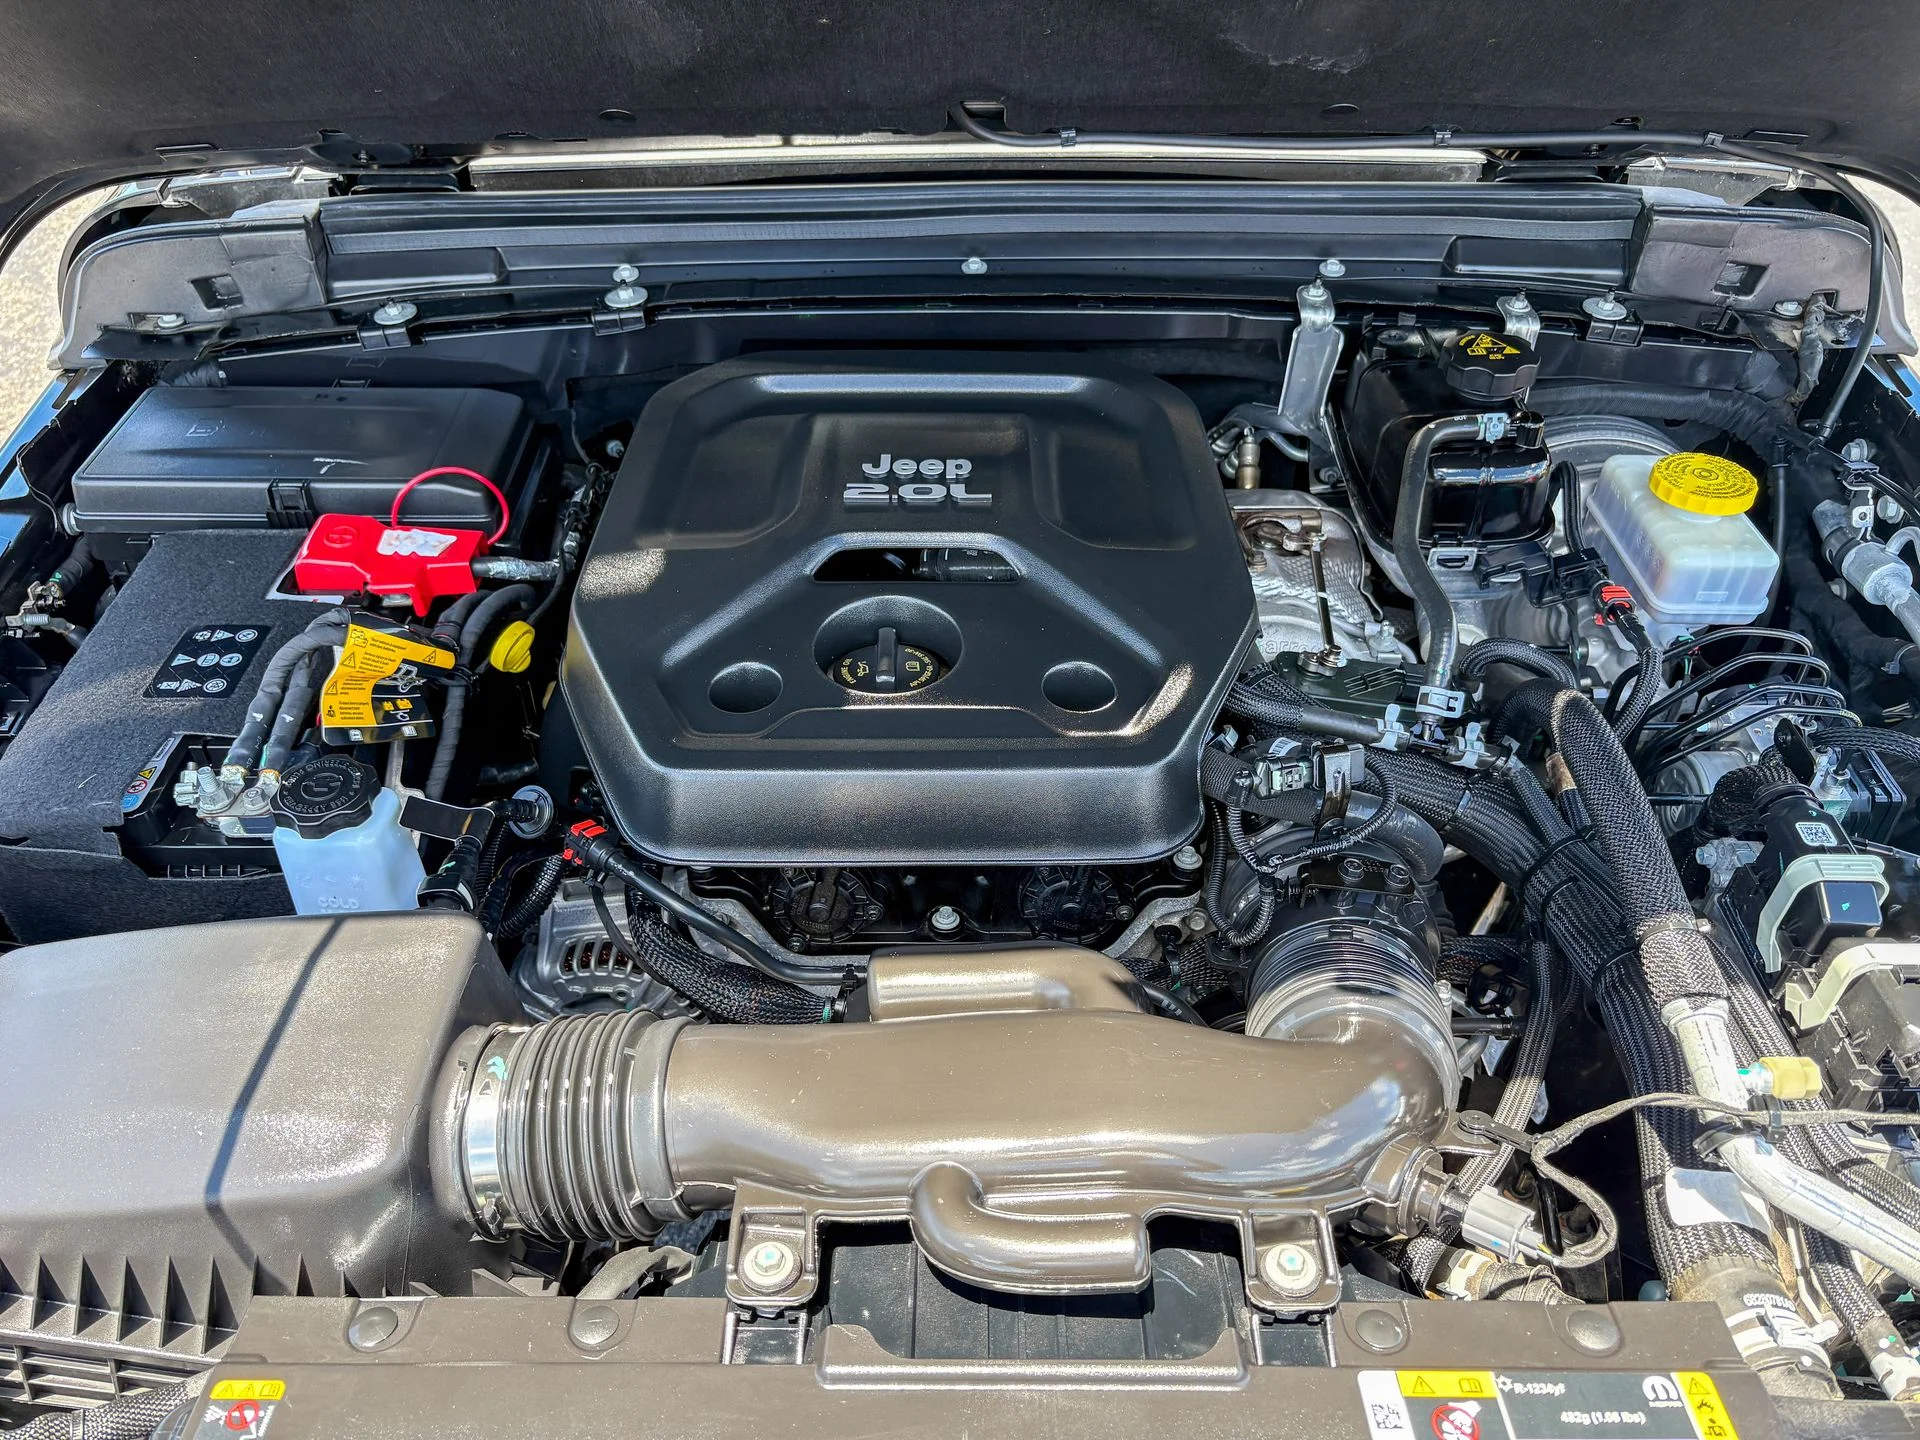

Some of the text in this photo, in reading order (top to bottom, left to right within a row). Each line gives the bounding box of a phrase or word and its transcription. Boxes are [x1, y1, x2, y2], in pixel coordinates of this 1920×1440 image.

[861, 453, 973, 480] Jeep
[843, 483, 993, 503] 2.0L
[317, 897, 360, 909] COLD
